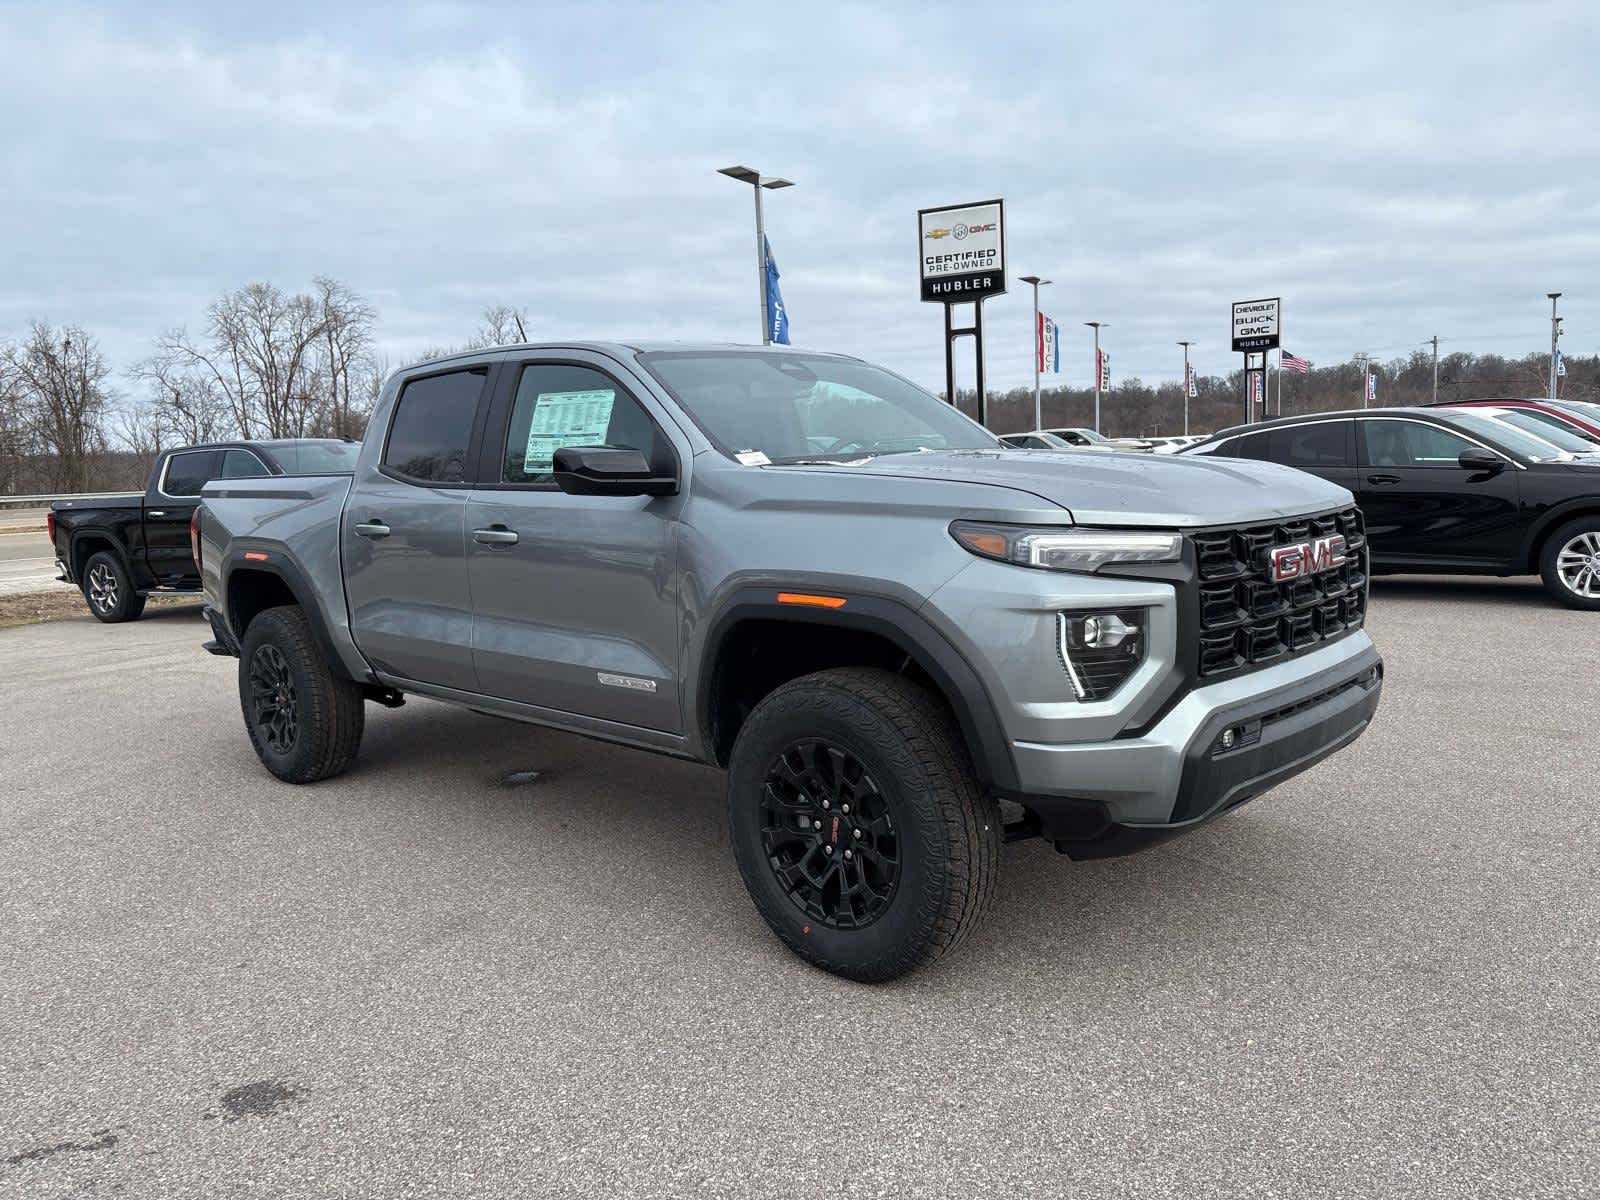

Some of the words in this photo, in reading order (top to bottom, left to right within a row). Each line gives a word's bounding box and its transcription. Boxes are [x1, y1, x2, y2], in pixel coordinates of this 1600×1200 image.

[926, 249, 996, 264] CERTIFIED
[929, 258, 993, 272] PRE-OWNED
[932, 277, 992, 293] HUBLER
[1235, 304, 1275, 314] CHEVROLET
[1235, 315, 1275, 325] BUICK
[1240, 326, 1270, 336] GMC
[1240, 339, 1270, 347] HUBLER
[1270, 534, 1346, 582] GMC
